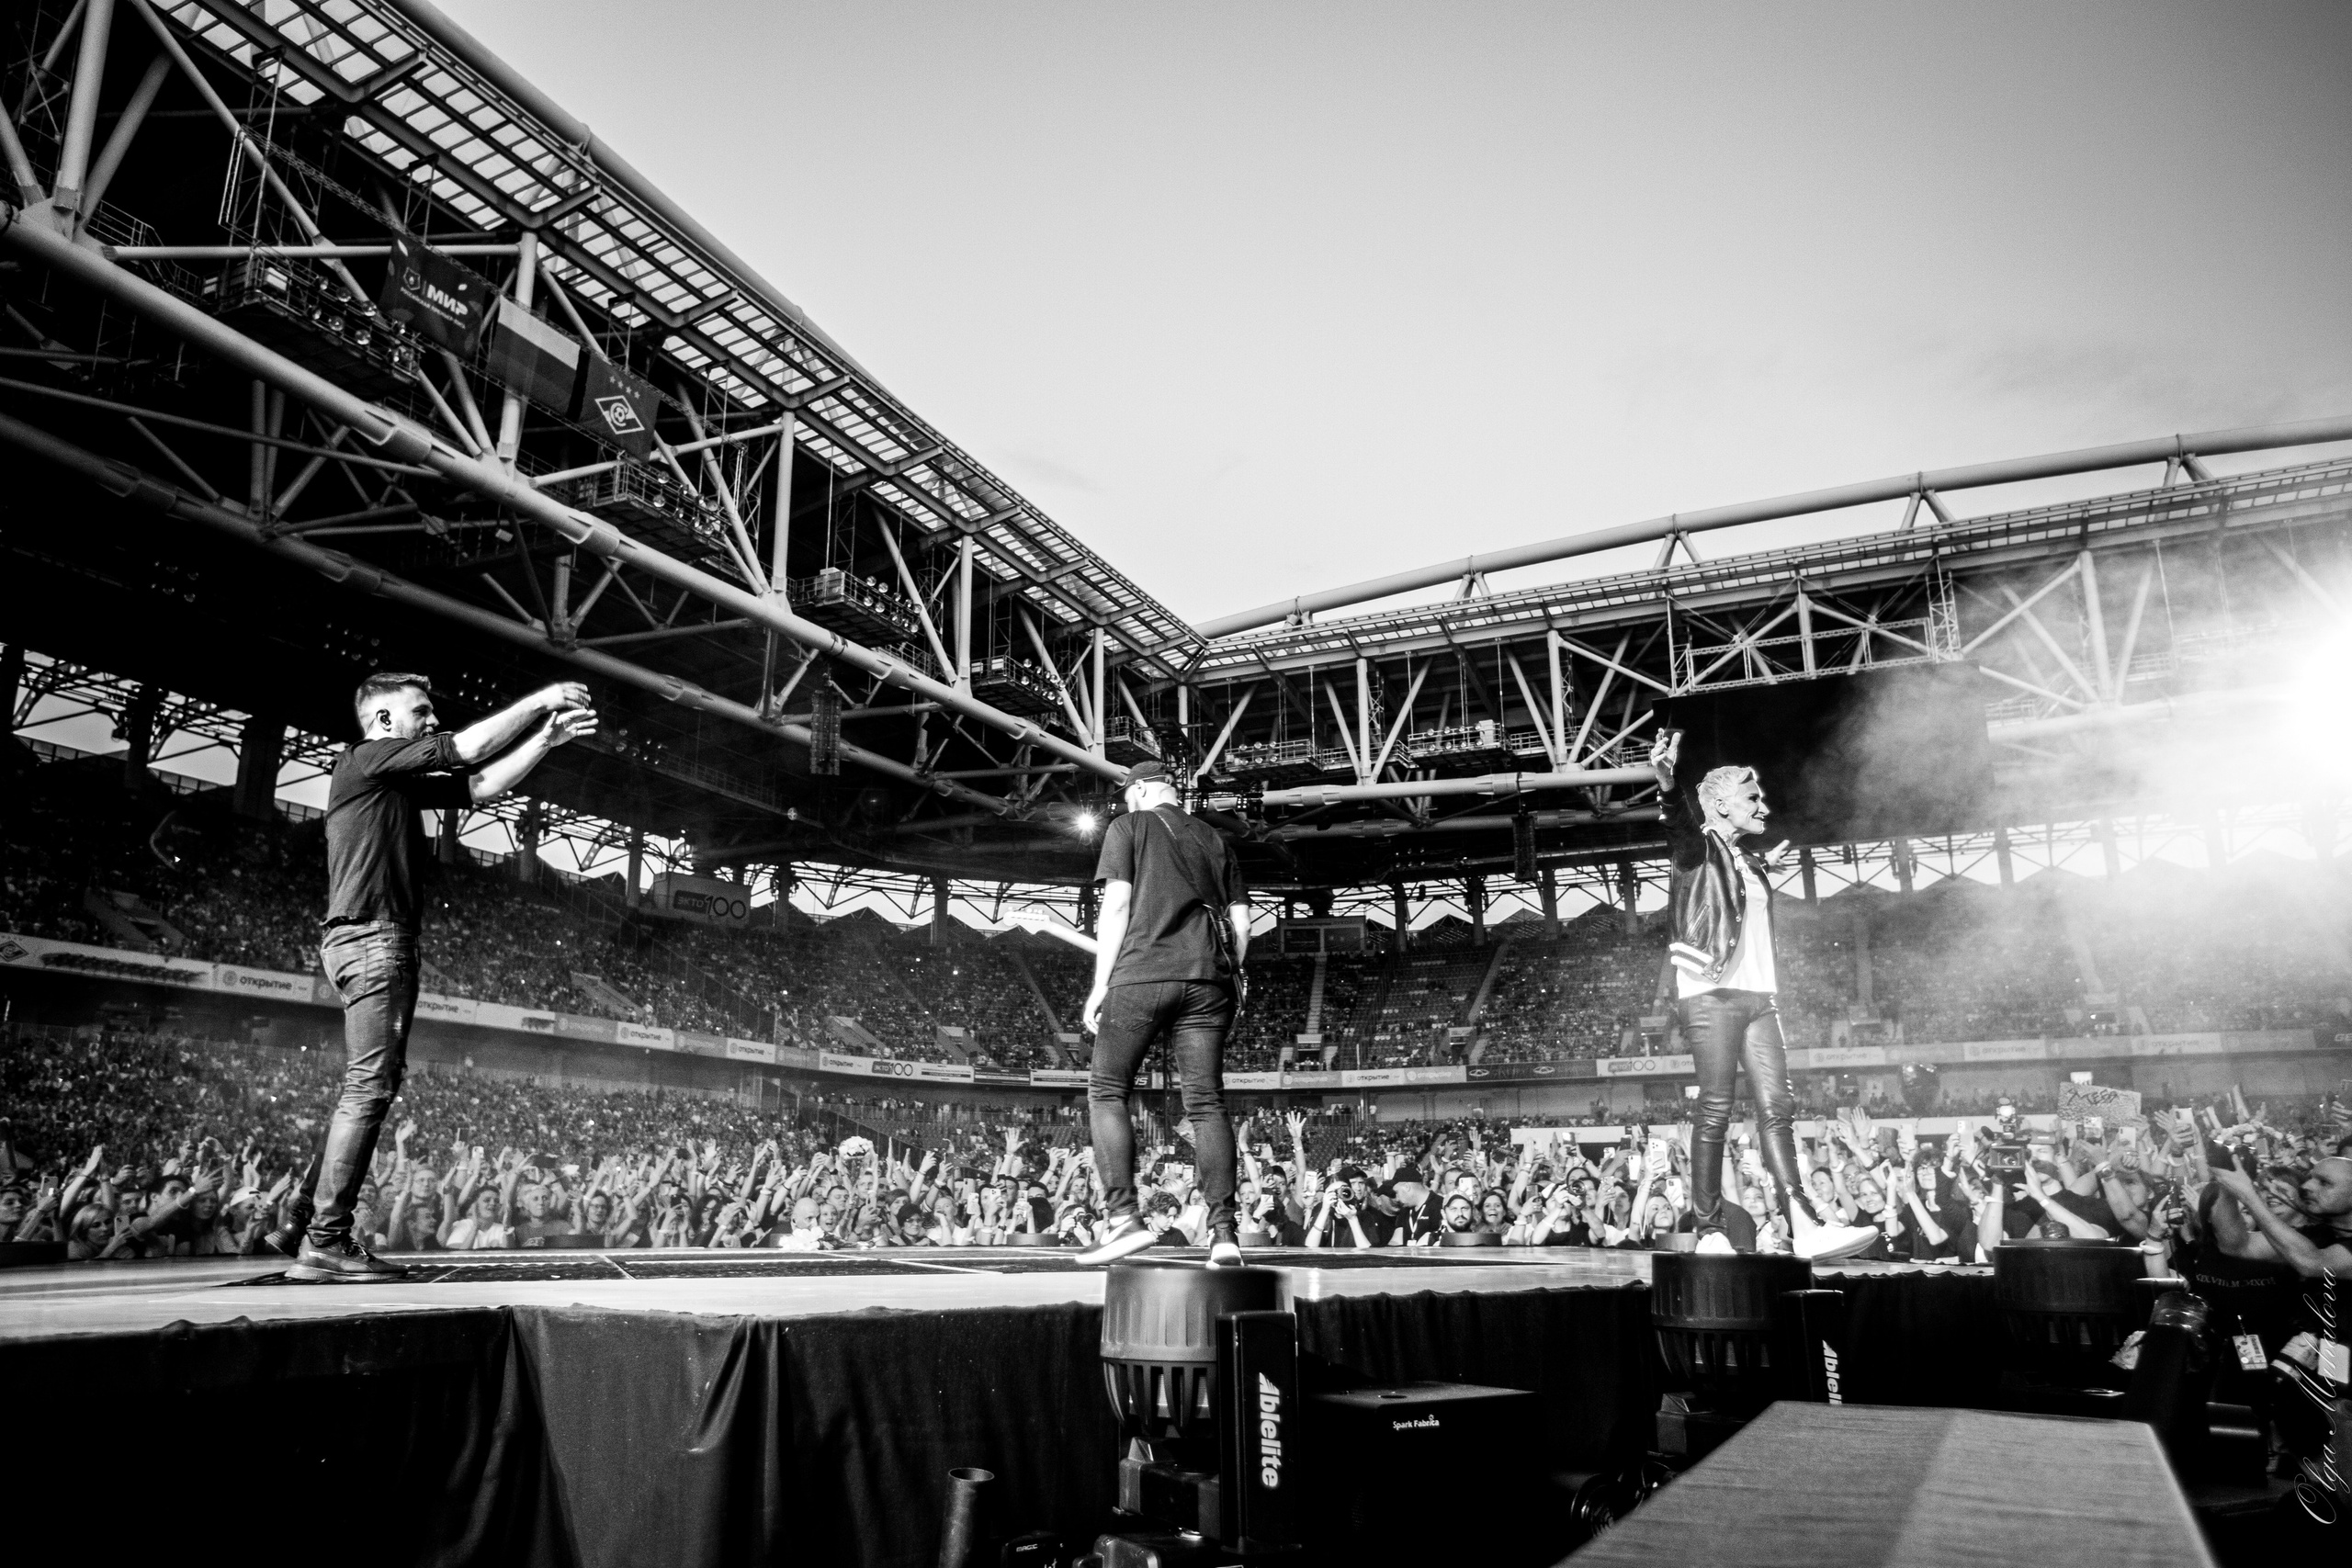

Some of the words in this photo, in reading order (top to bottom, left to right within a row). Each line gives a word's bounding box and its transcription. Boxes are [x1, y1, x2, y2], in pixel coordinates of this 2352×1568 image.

[427, 284, 469, 315] МИР
[239, 976, 293, 990] открытие
[417, 1000, 459, 1013] открытие
[630, 1030, 662, 1042] открытие
[1231, 1077, 1266, 1086] открытие
[1356, 1074, 1390, 1083] открытие
[1259, 1371, 1283, 1489] Ablelite
[1392, 1420, 1413, 1431] Spark
[1413, 1416, 1441, 1427] Fabrica
